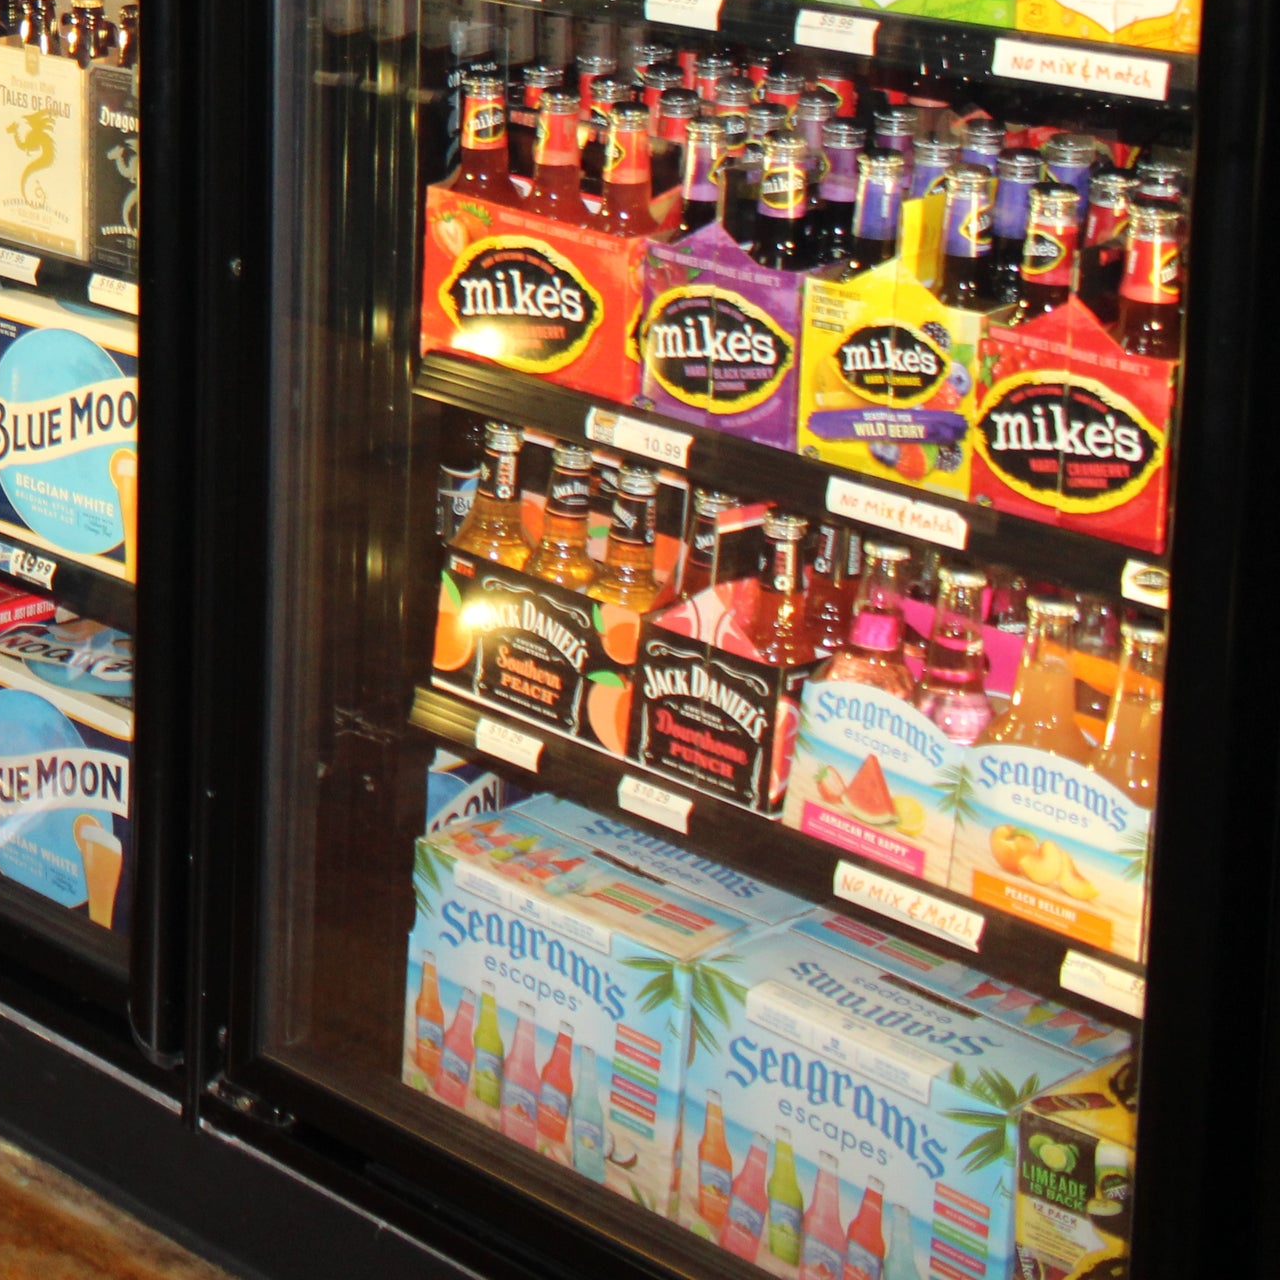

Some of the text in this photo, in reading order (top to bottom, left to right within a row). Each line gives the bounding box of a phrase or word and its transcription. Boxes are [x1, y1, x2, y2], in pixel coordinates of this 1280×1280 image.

[1041, 57, 1074, 74] Mix
[1095, 65, 1152, 89] Match
[31, 94, 44, 111] OF
[45, 95, 71, 120] GOLD
[461, 269, 584, 322] mike's
[653, 316, 777, 366] mike's
[842, 341, 940, 376] mike's
[70, 390, 138, 439] MOO
[853, 421, 927, 440] WILD BERRY
[992, 404, 1143, 461] mike's
[643, 435, 681, 459] 10.99
[15, 471, 115, 517] BELGIAN WHITE
[864, 499, 895, 519] Mix
[909, 512, 956, 536] Match
[522, 600, 590, 669] DANIEL'S
[497, 644, 562, 690] Southern
[500, 674, 559, 705] PEACH
[644, 666, 767, 739] JACK DANIEL'S
[655, 709, 748, 765] Downhome
[816, 690, 945, 768] Seagram's
[844, 727, 911, 764] escapes
[35, 754, 124, 803] MOON
[978, 754, 1128, 833] Seagram's
[1011, 791, 1089, 830] escapes
[866, 883, 901, 909] Mix
[925, 906, 974, 939] Match
[1005, 886, 1077, 922] PEACH BELLINI
[440, 899, 629, 1022] Seagram's
[484, 953, 581, 1012] escapes
[724, 1035, 949, 1180] Seagram's
[777, 1096, 891, 1167] escapes
[1021, 1159, 1088, 1200] LIMEADE
[1029, 1179, 1085, 1213] IS BACK
